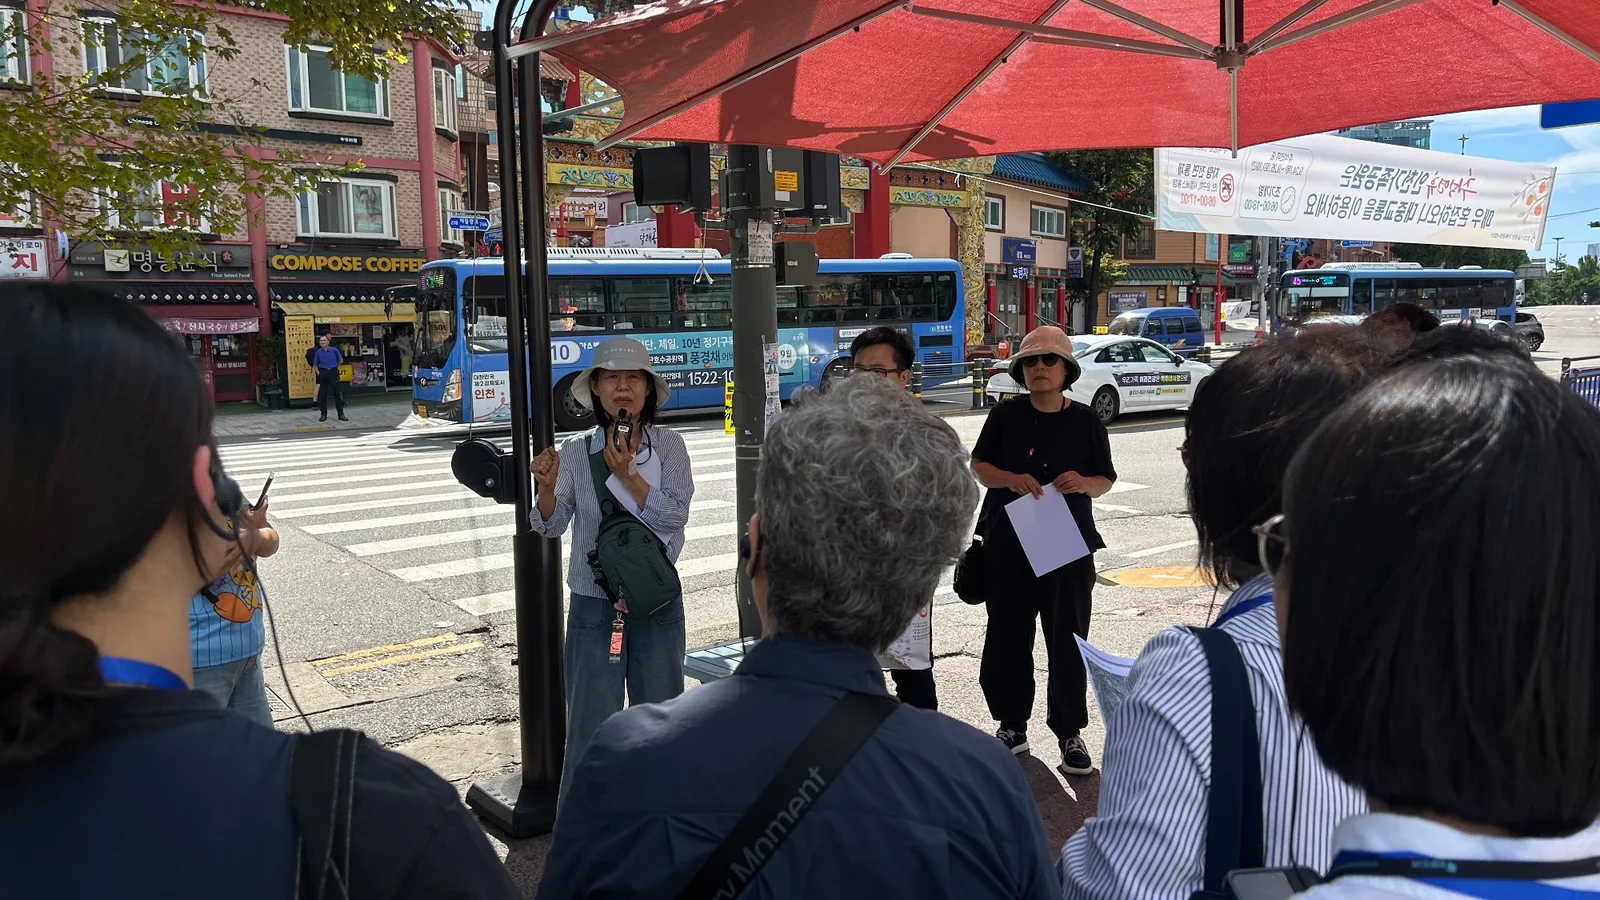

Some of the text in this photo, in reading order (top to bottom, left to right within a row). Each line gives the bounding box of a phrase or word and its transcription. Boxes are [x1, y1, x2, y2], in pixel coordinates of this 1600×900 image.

[272, 254, 362, 272] COMPOSE
[658, 338, 679, 350] 제일.
[682, 338, 700, 348] 10년
[690, 350, 720, 364] 풍경채
[780, 350, 792, 358] 9월
[474, 388, 495, 400] 인천
[730, 765, 826, 883] Moment
